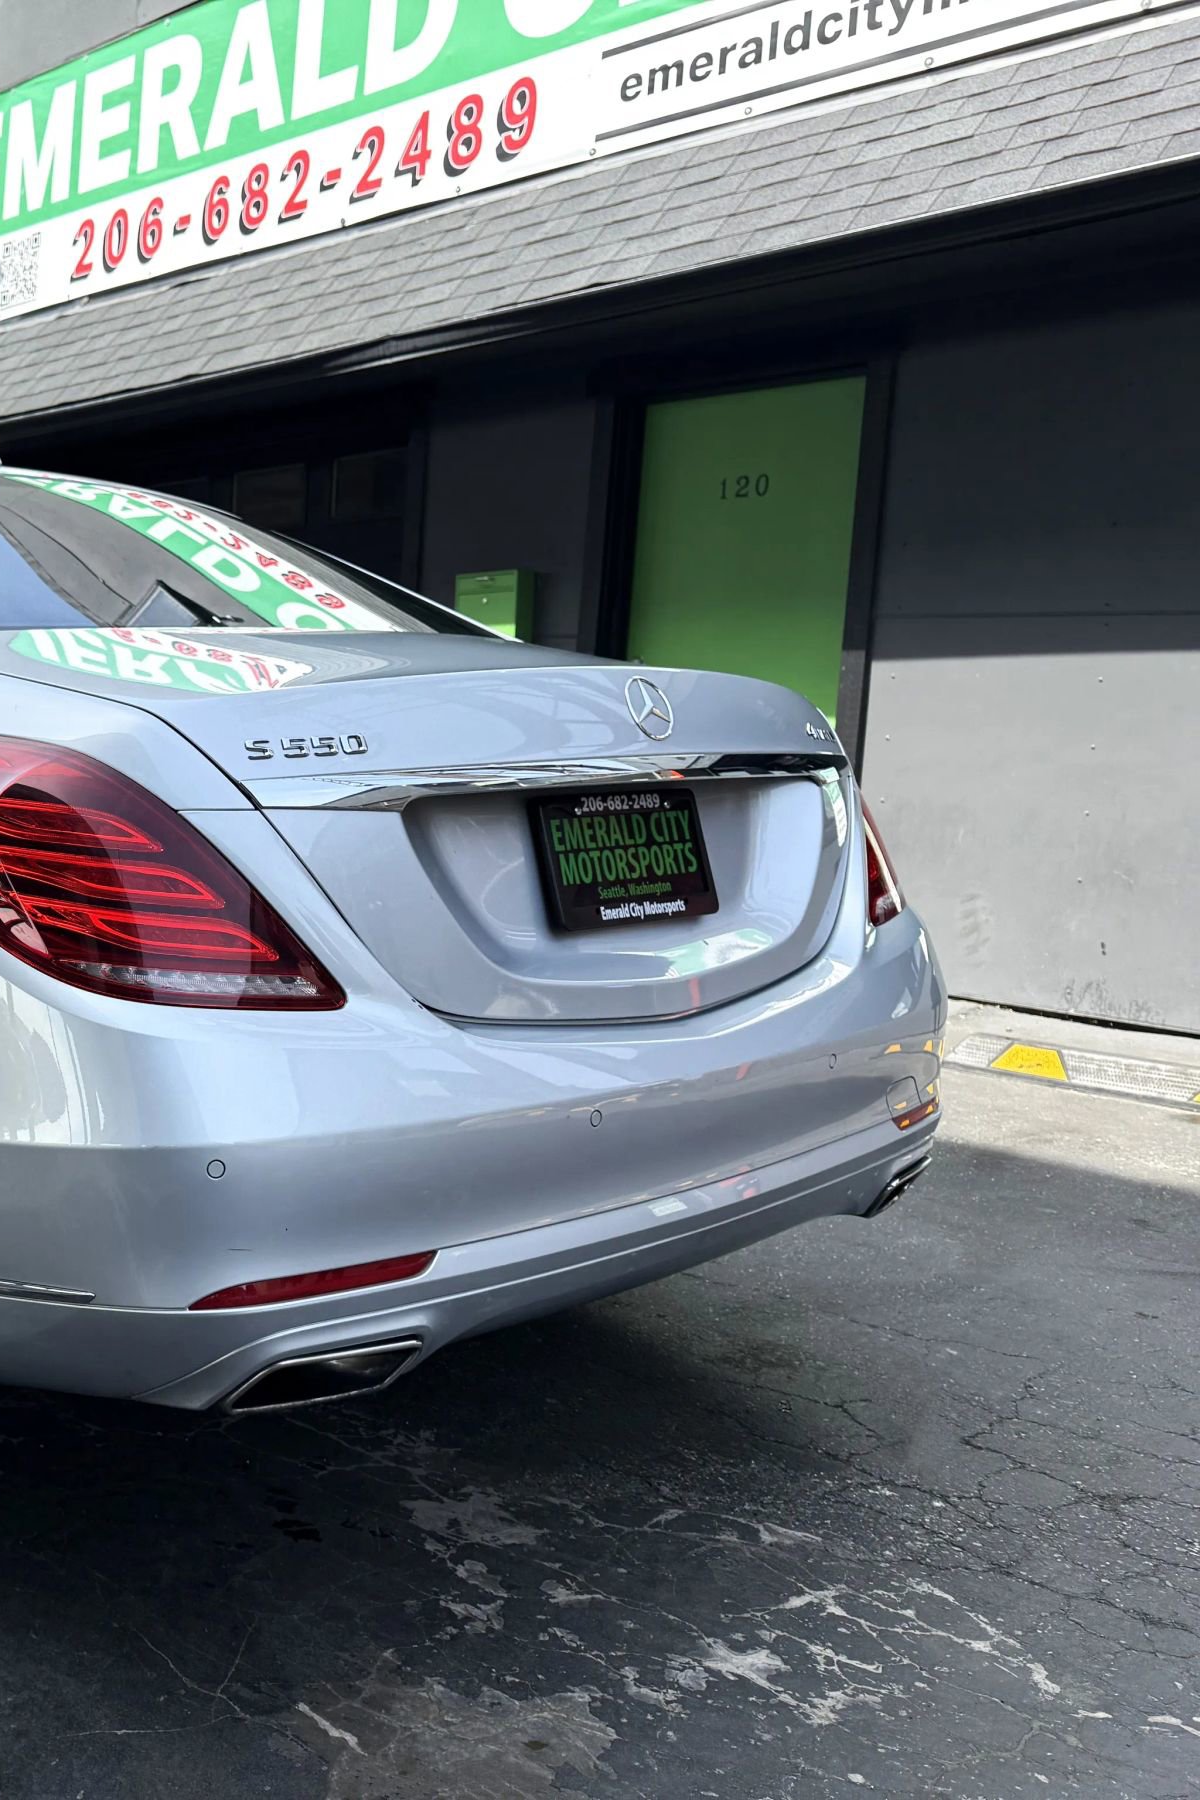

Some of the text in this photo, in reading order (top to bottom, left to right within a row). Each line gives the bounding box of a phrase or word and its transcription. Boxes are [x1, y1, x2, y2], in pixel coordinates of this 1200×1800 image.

[620, 0, 969, 102] emeraldcity
[70, 76, 537, 283] 206-682-2489
[720, 474, 770, 500] 120
[245, 733, 369, 760] S 550
[581, 793, 660, 813] 206-682-2489
[551, 809, 692, 852] EMERALD CITY
[559, 842, 698, 886] MOTORSPORTS
[598, 881, 672, 899] Seattle, Washington
[600, 899, 686, 921] Emerald City Motorsports
